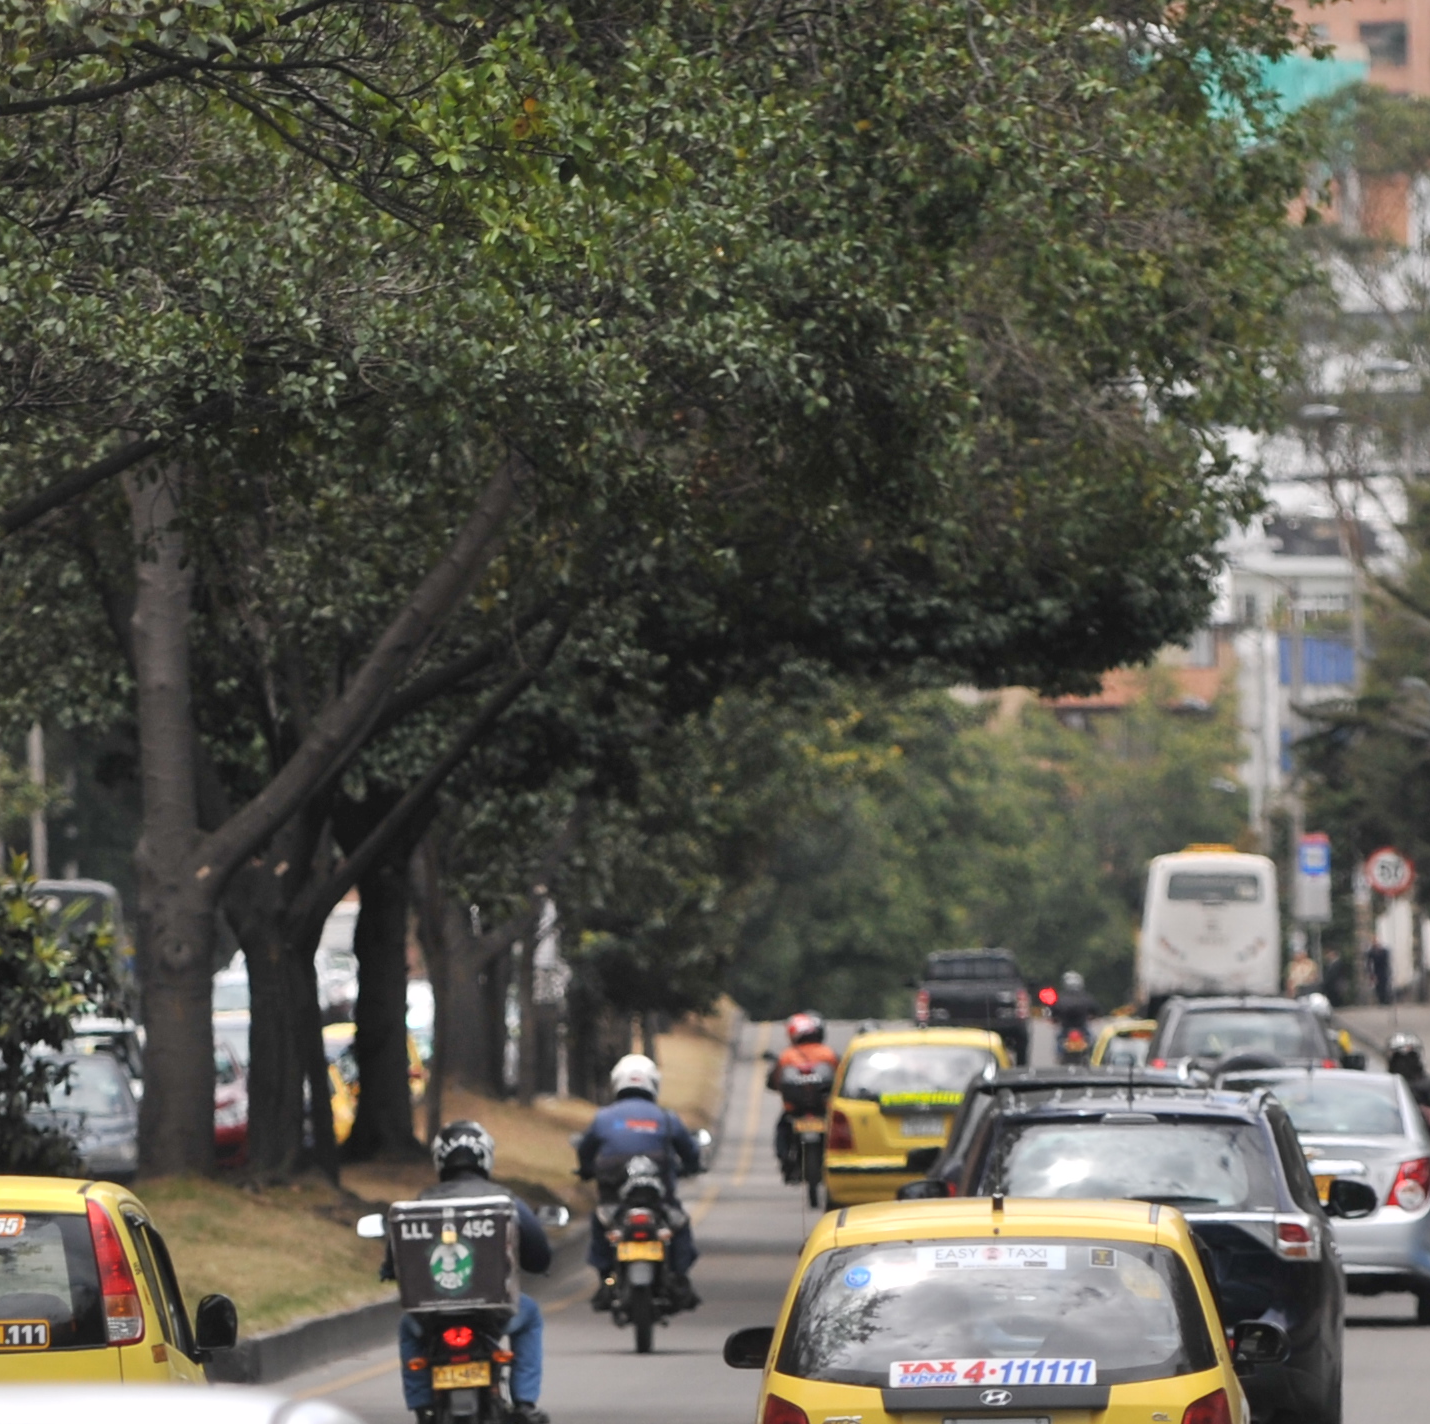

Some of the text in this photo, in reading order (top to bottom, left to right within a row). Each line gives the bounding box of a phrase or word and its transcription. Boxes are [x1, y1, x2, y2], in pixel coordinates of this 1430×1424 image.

[400, 1222, 433, 1239] LLL
[935, 1246, 1047, 1260] EASY TAXI
[898, 1373, 958, 1386] express
